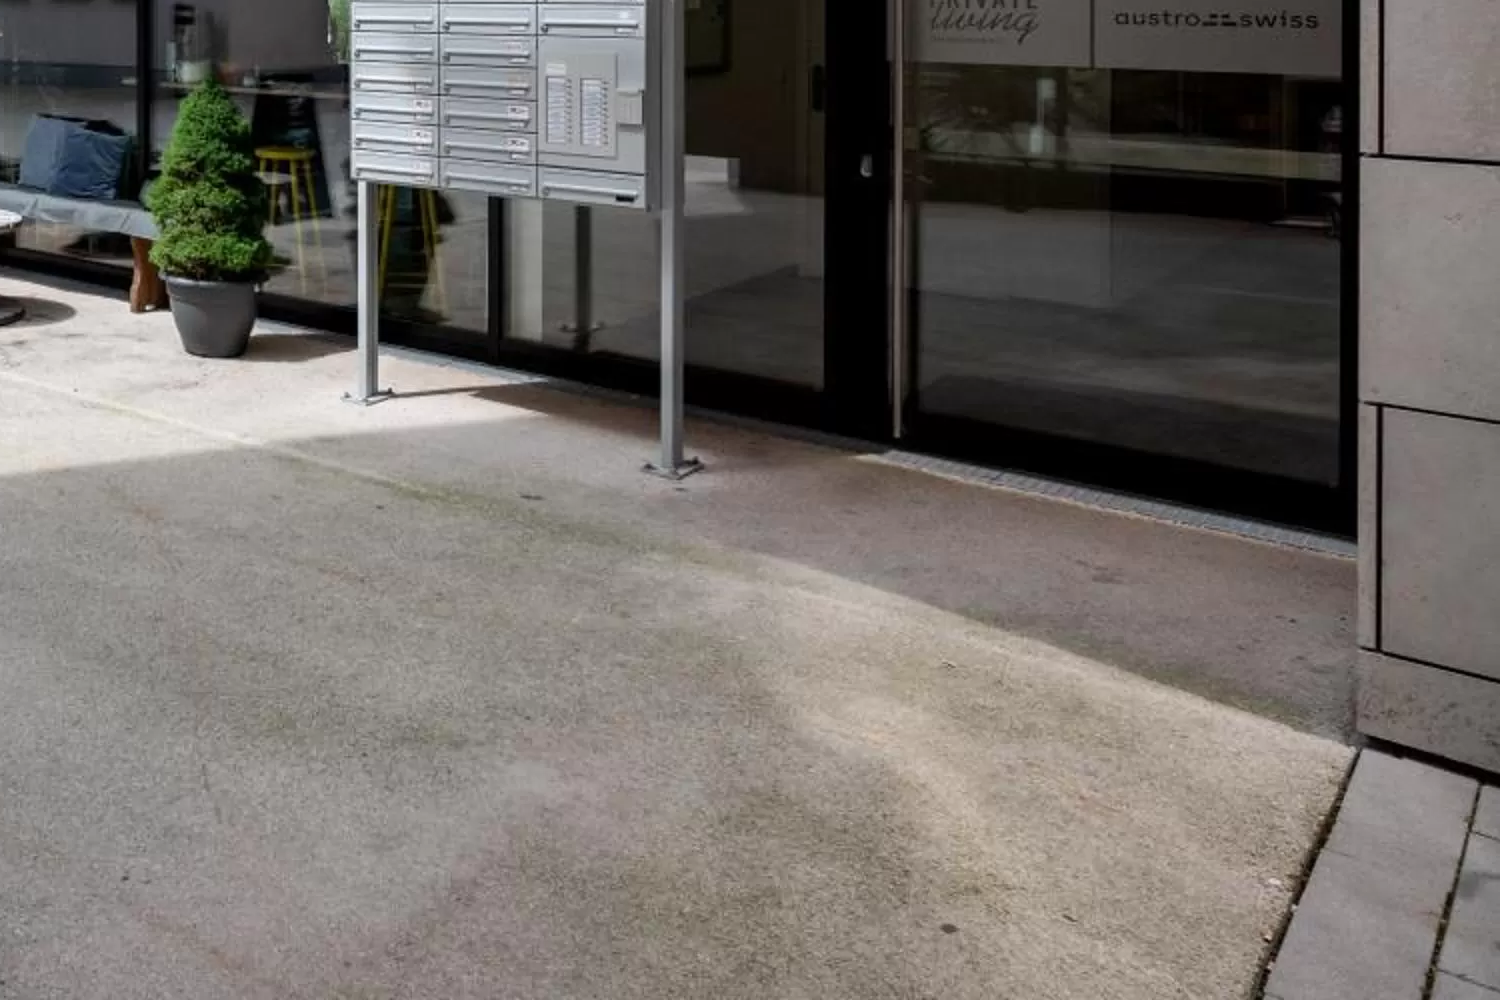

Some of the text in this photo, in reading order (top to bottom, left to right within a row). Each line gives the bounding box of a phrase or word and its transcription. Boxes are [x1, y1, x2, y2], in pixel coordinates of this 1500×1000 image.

[930, 1, 1040, 46] living
[1114, 9, 1321, 29] austro swiss
